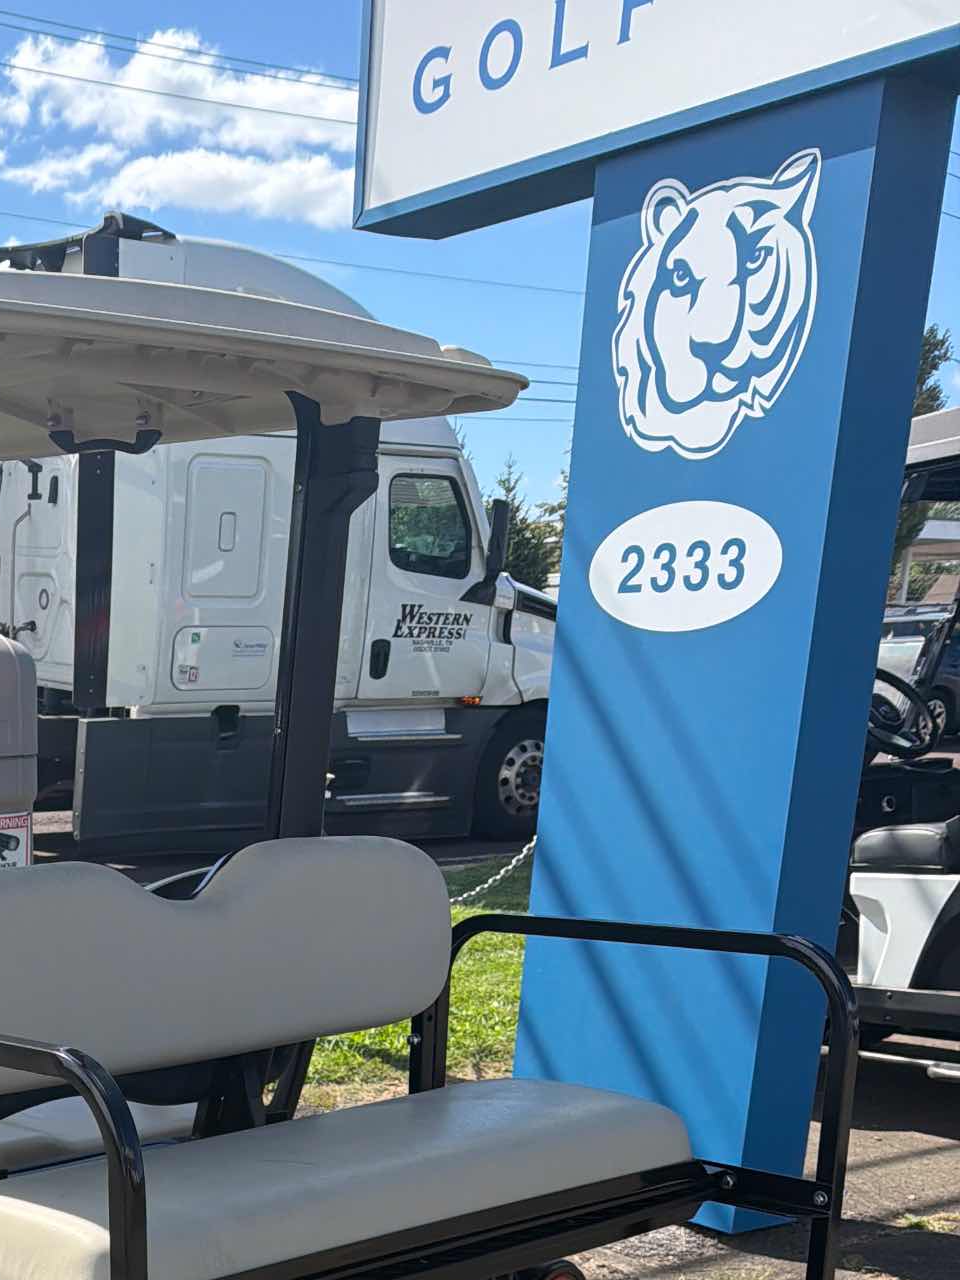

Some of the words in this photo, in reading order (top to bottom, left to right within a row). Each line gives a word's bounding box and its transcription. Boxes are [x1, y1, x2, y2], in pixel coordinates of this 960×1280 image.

[413, 0, 654, 114] GOLF
[617, 537, 746, 594] 2333
[392, 618, 464, 640] EXPRESS
[401, 603, 473, 626] WESTERN
